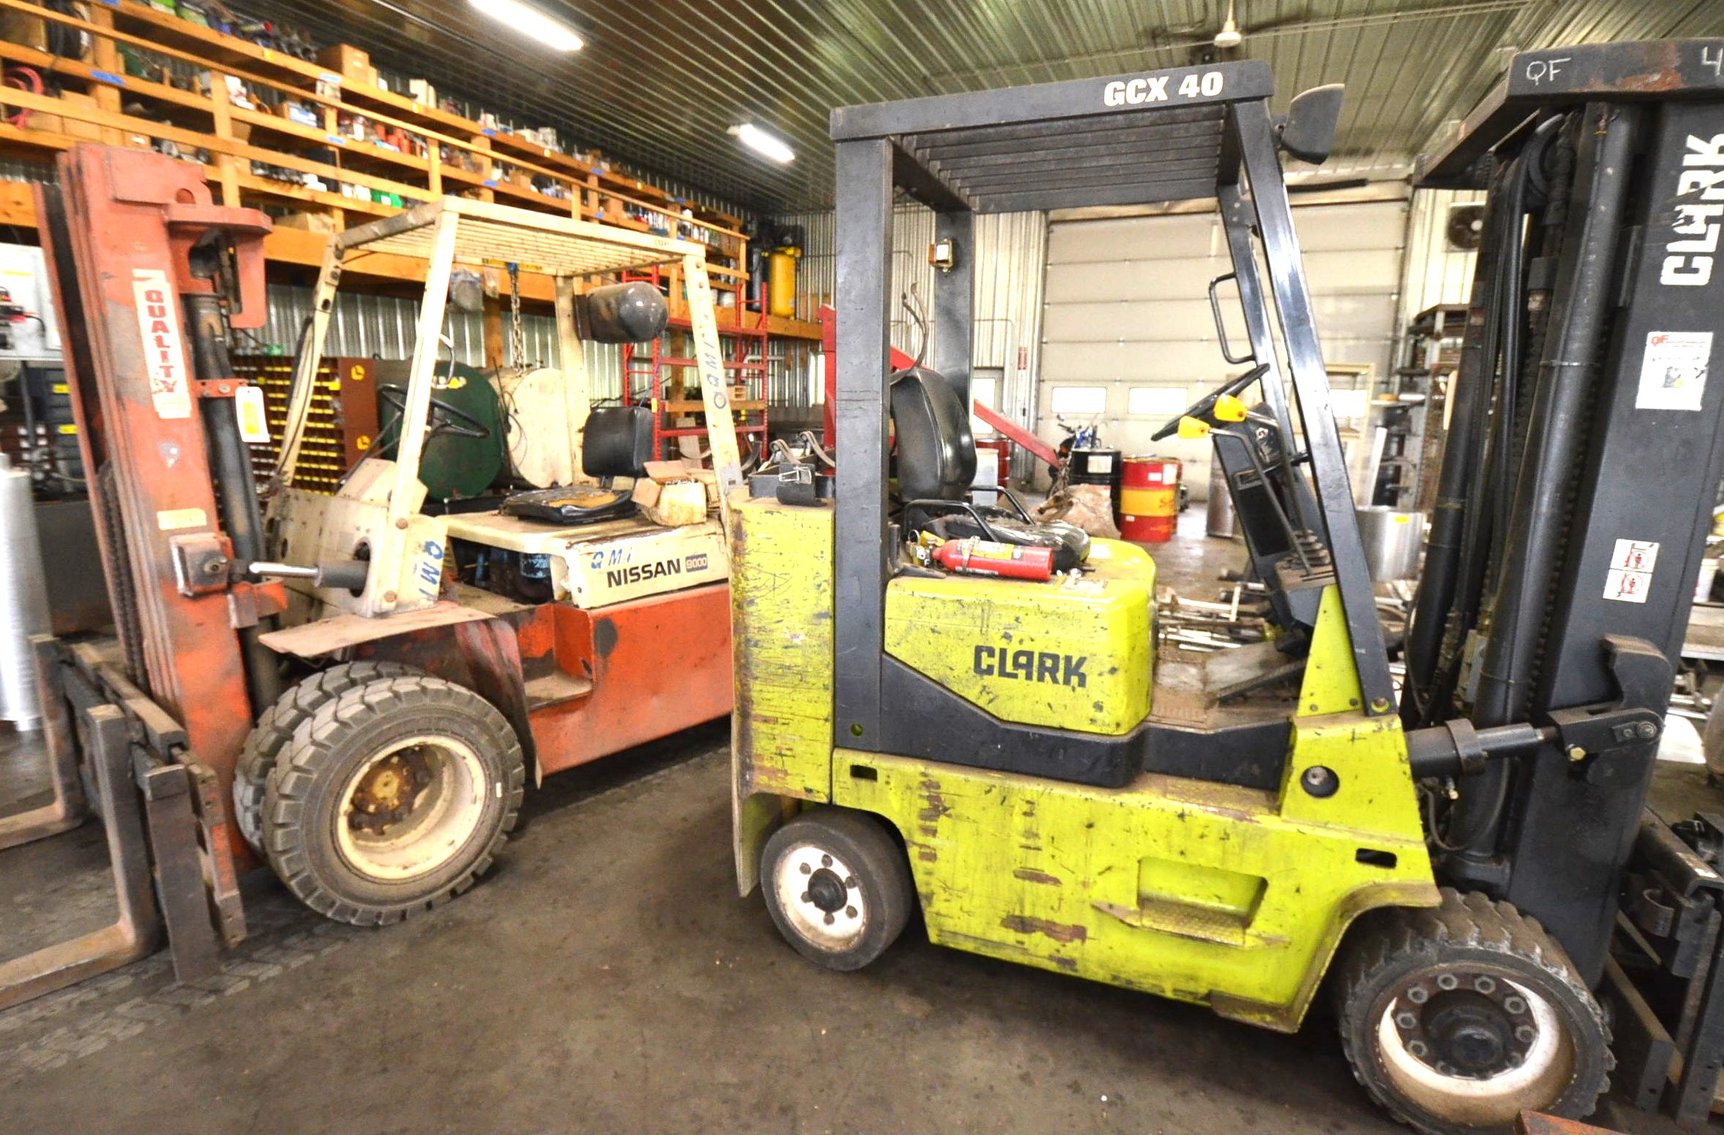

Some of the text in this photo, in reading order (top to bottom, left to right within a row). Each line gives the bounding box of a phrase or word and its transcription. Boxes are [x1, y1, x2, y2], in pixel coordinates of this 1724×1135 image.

[1103, 71, 1224, 107] GCX 40
[1525, 57, 1572, 86] QF
[1659, 133, 1724, 286] CLARK
[145, 289, 177, 393] QUALITY
[607, 557, 707, 588] NISSAN 9000
[973, 645, 1087, 689] CLARK
